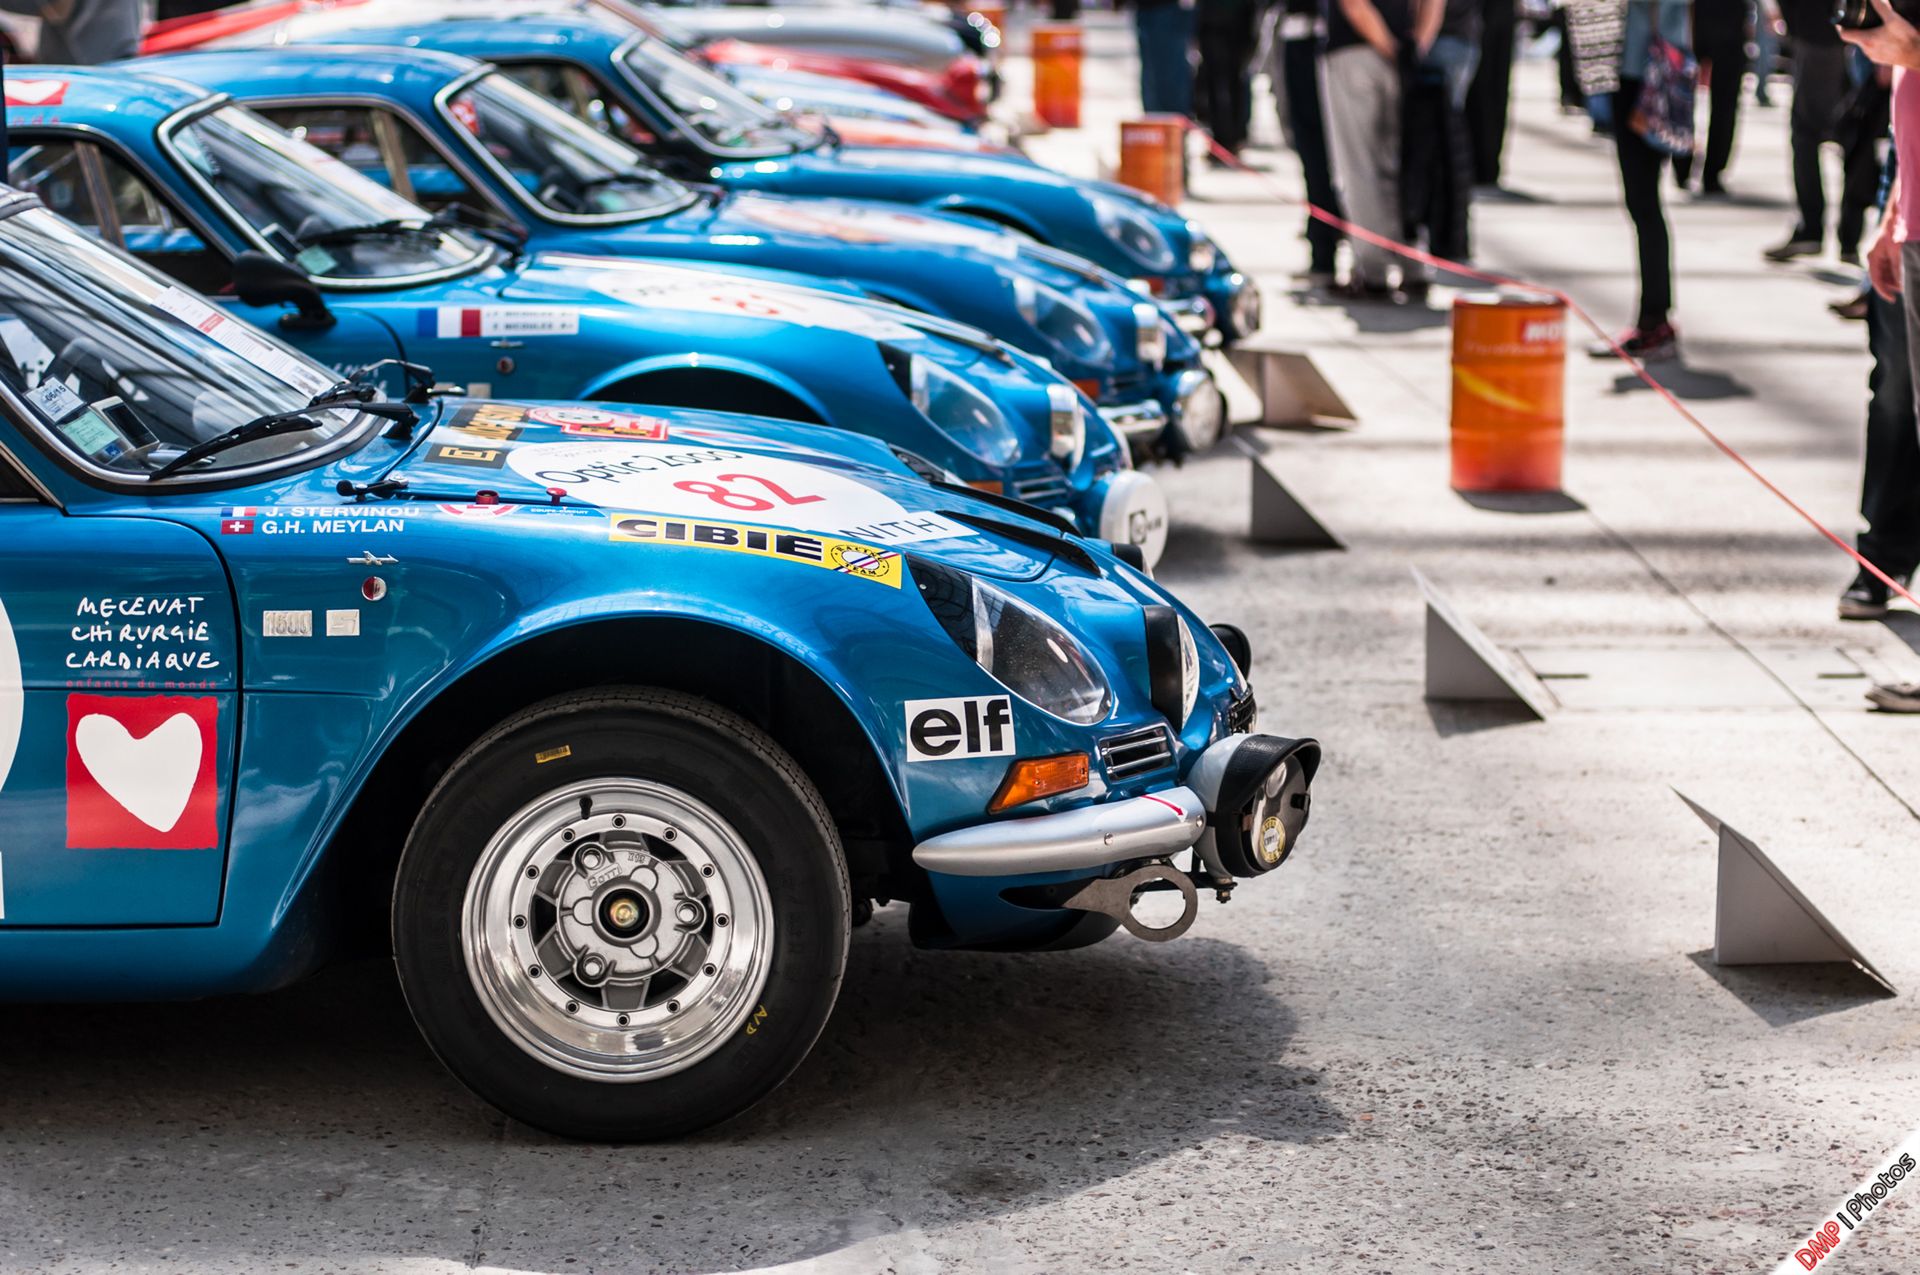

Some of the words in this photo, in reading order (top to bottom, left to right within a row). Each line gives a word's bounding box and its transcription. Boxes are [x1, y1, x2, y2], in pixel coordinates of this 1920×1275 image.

[672, 473, 827, 512] 82
[290, 507, 420, 517] STERVINOU
[261, 520, 306, 534] G.H.
[312, 519, 405, 533] MEYLAN
[66, 679, 129, 688] enfants
[137, 679, 156, 688] du
[164, 679, 217, 689] monde
[909, 699, 1011, 757] elf
